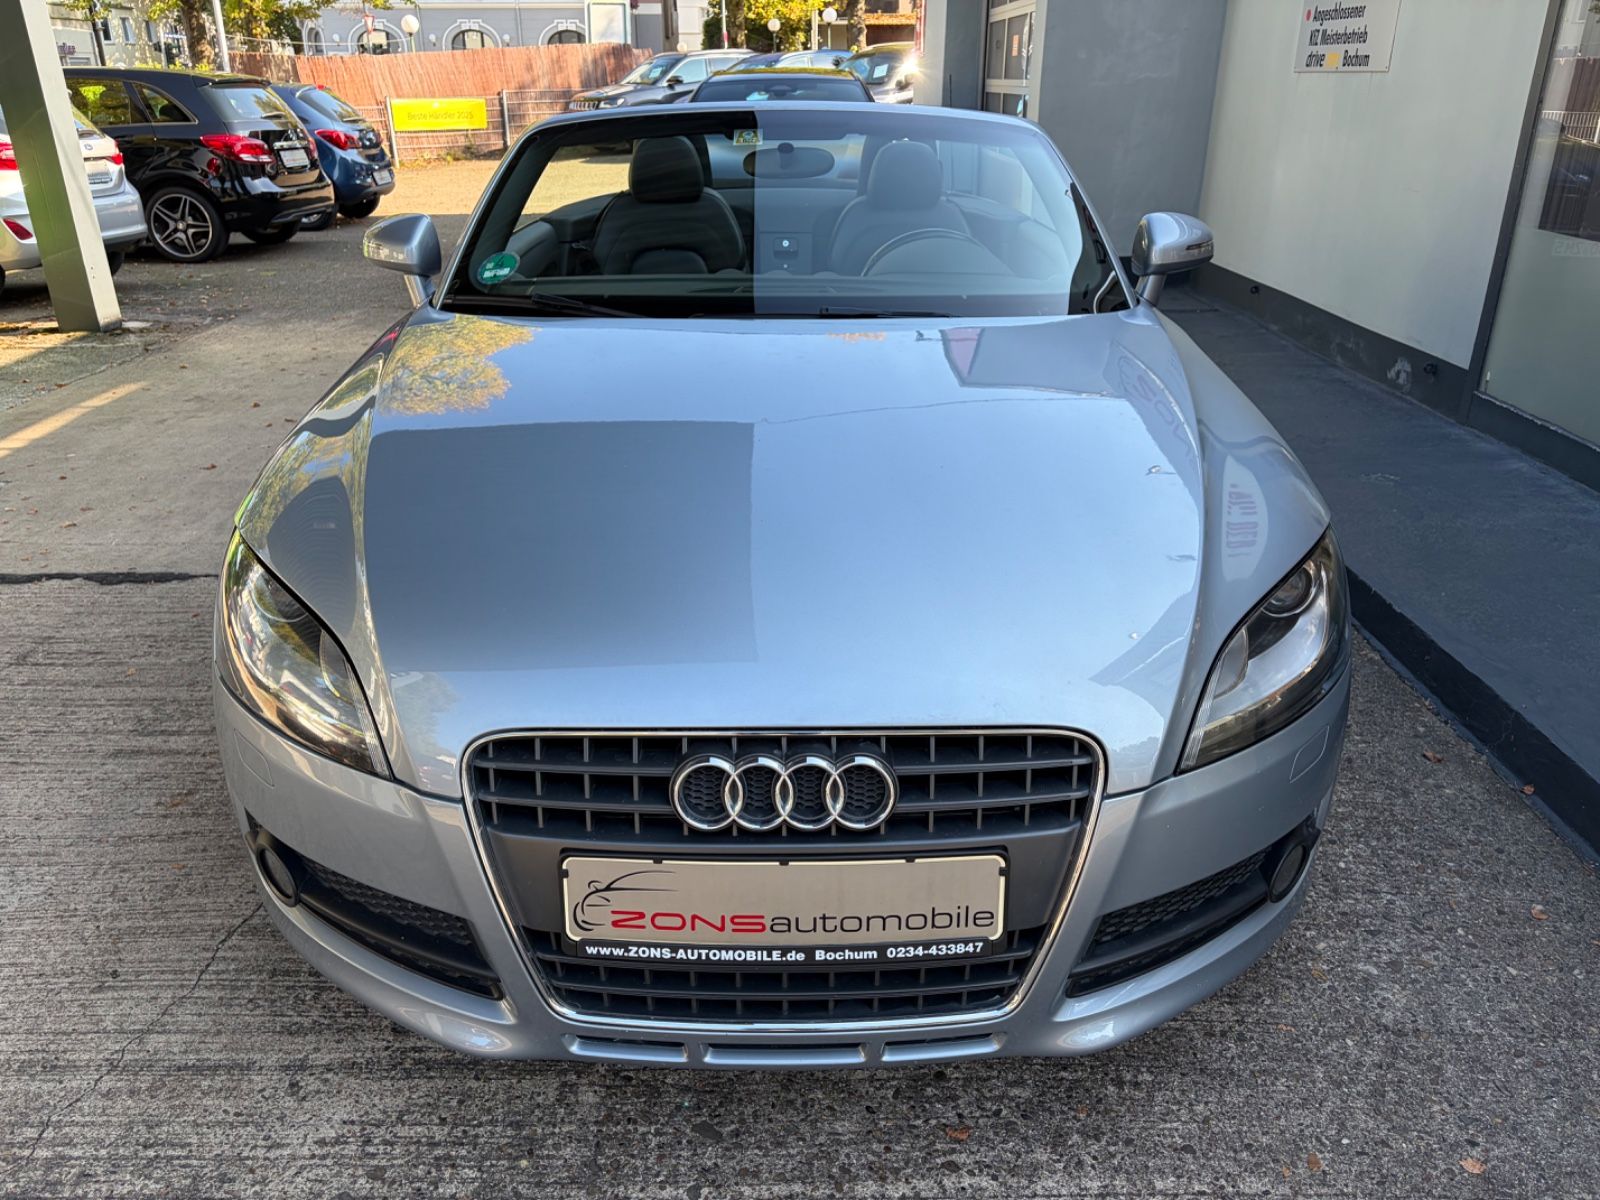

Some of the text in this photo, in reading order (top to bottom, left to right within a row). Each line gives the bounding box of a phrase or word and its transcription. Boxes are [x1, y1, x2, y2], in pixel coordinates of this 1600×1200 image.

[1312, 1, 1366, 25] Angeschlossener
[1320, 24, 1368, 46] Meisterbetrieb
[1305, 48, 1370, 67] drive Bochum
[585, 942, 984, 961] www.ZONS-AUTOMOBILE.de Bochum 0234-433847
